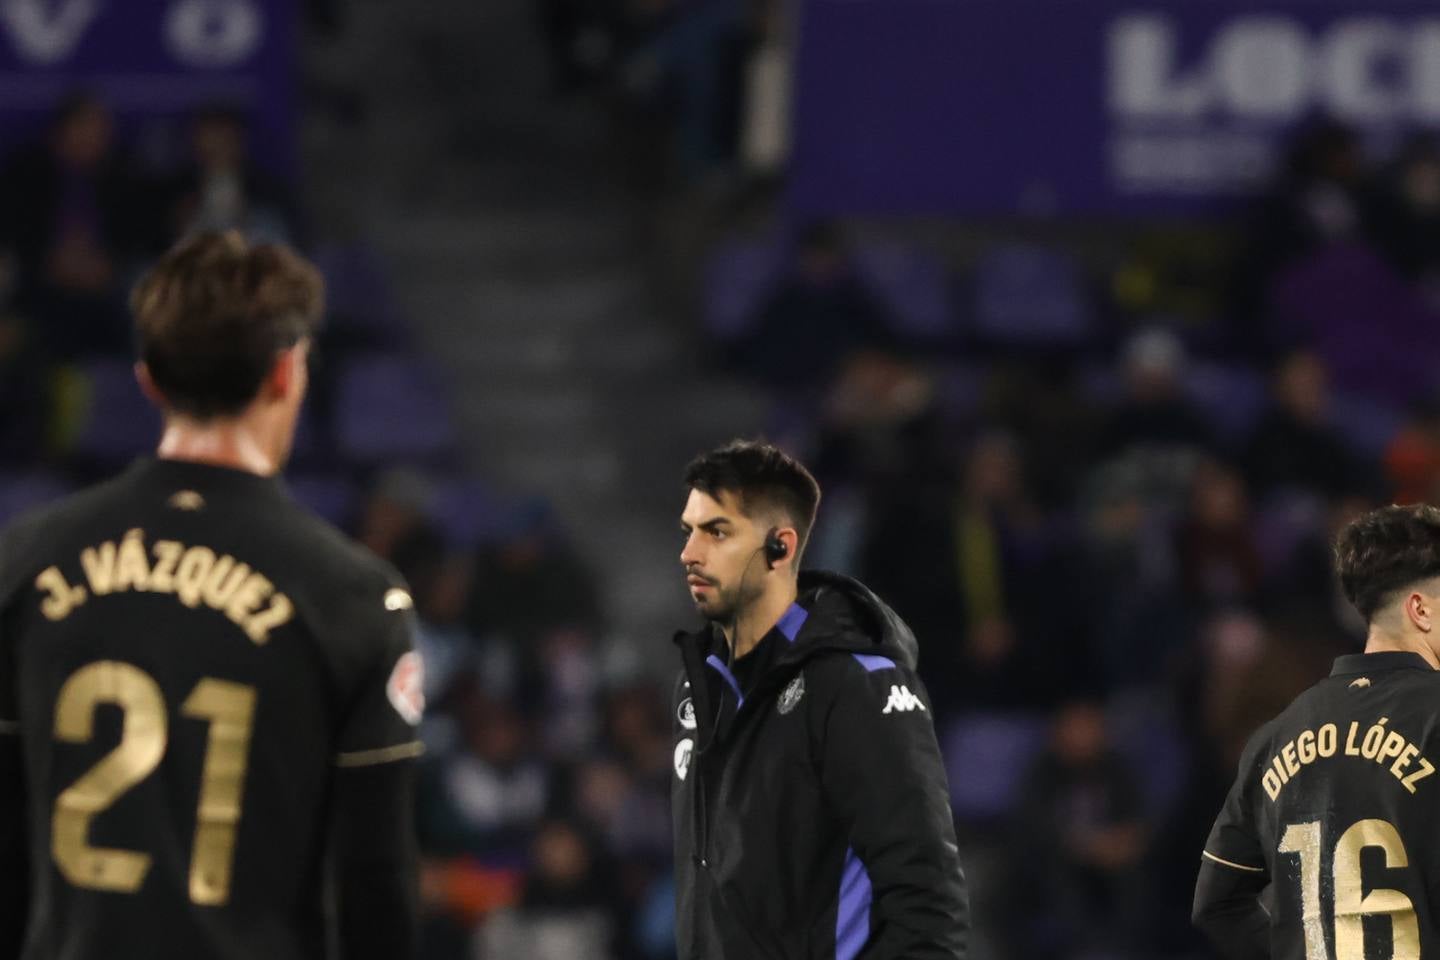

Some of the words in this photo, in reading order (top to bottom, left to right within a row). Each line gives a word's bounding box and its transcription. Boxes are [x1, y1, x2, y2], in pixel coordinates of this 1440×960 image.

[36, 566, 87, 621] J.
[81, 528, 294, 645] VÁZQUEZ
[53, 659, 257, 905] 21
[1262, 723, 1337, 801] DIEGO
[1345, 717, 1436, 794] LÓPEZ
